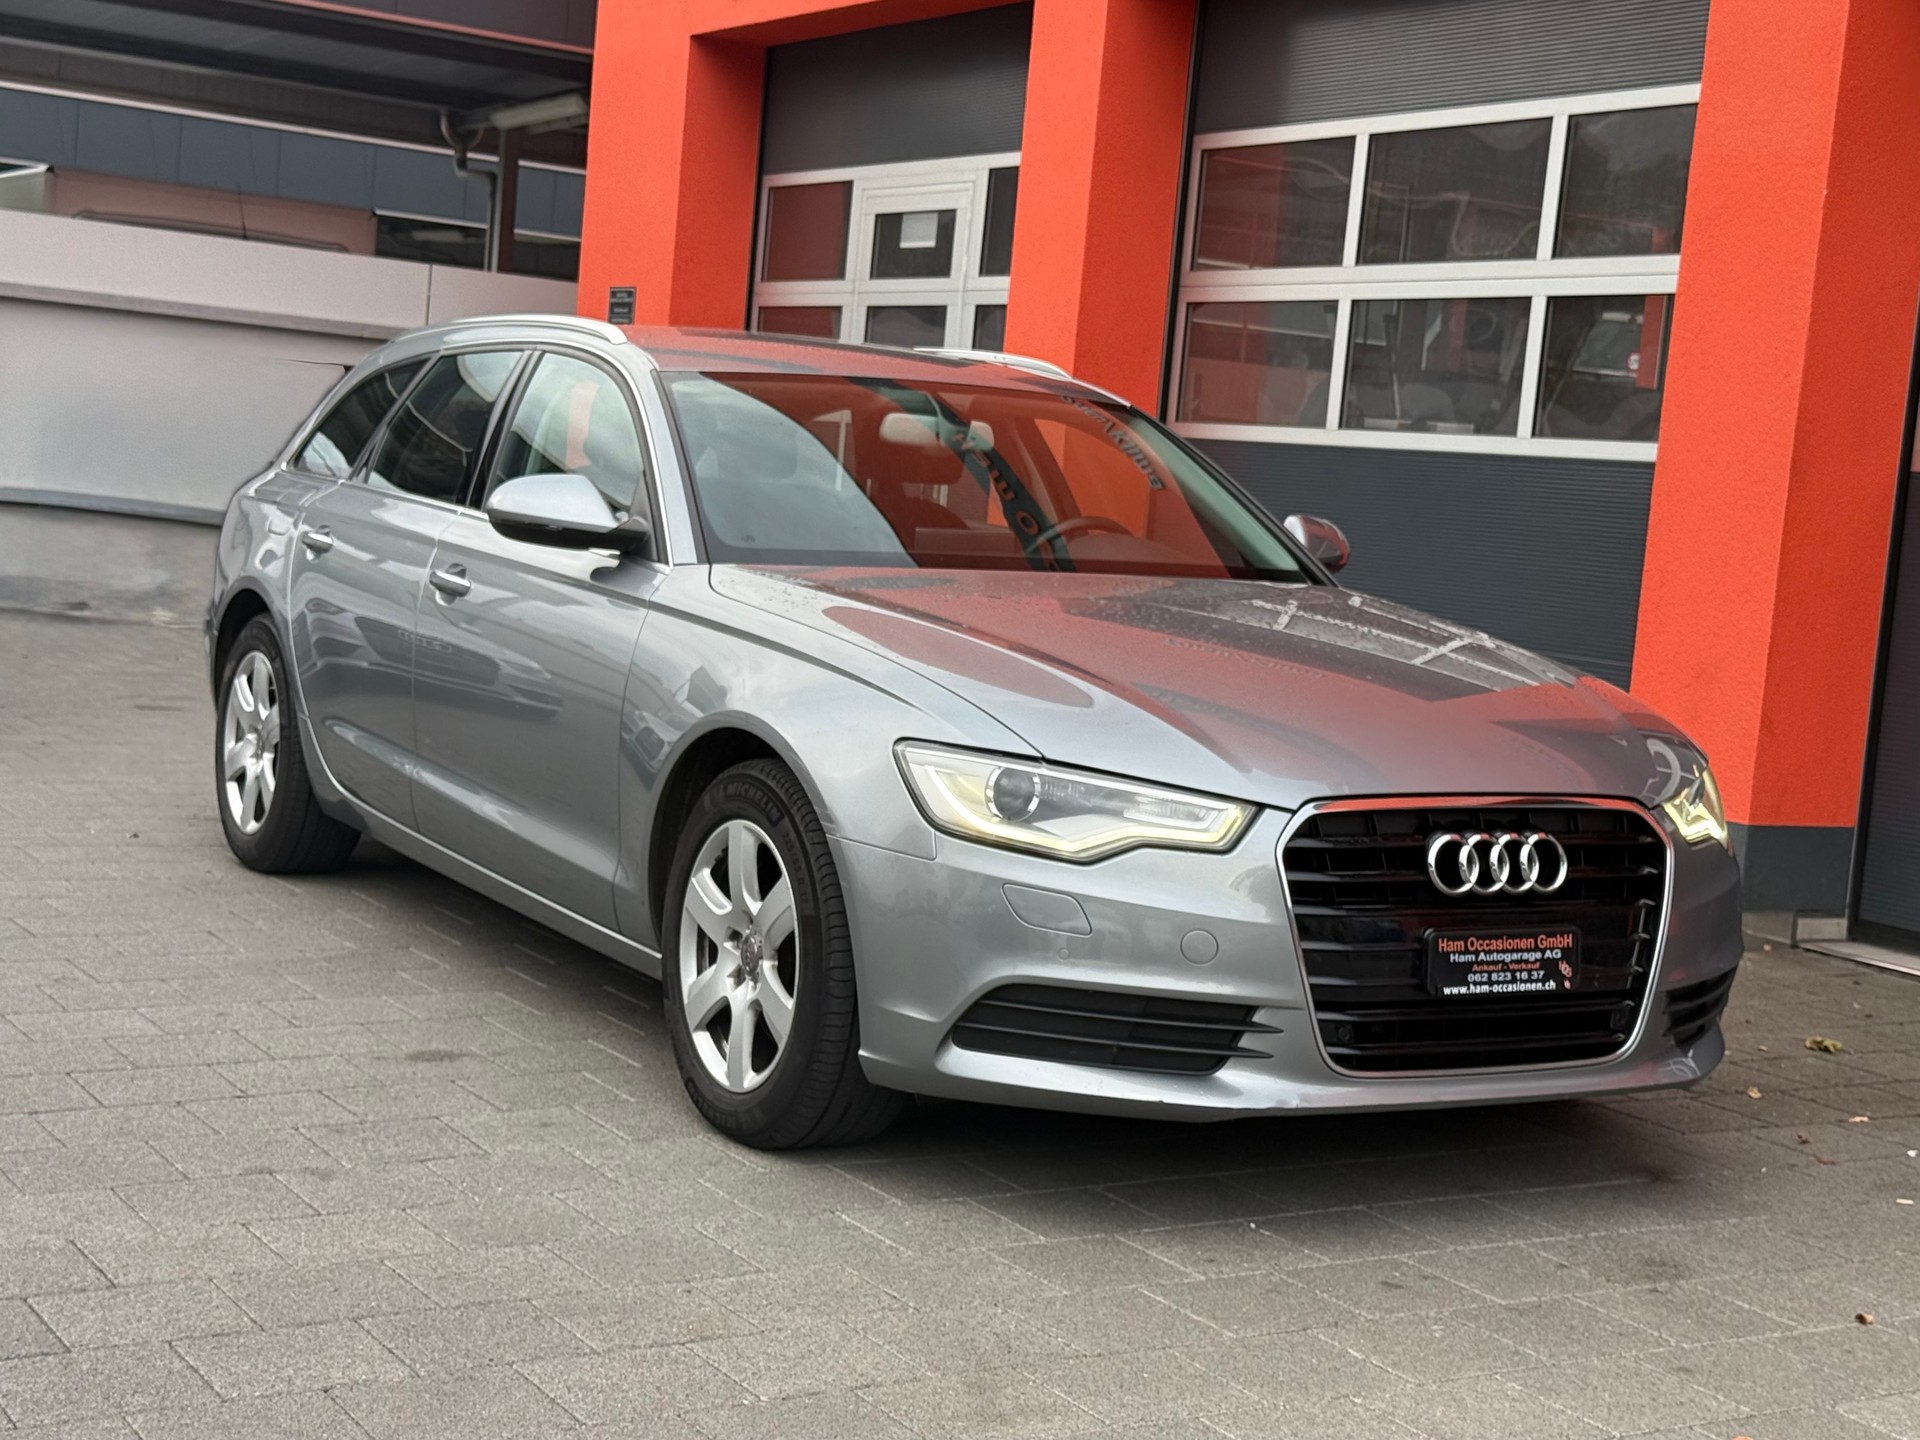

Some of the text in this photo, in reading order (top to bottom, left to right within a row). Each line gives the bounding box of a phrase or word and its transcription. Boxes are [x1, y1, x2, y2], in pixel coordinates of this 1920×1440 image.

[725, 782, 783, 826] MICHELIN
[1438, 933, 1572, 952] Ham Occasionen GmbH
[1450, 949, 1562, 963] Ham Autogarage AG
[1472, 963, 1501, 972] Ankauf
[1508, 962, 1541, 971] Verkauf
[1467, 970, 1545, 982] 062 823 16 37
[1443, 980, 1556, 995] www.ham-occasionen.ch
